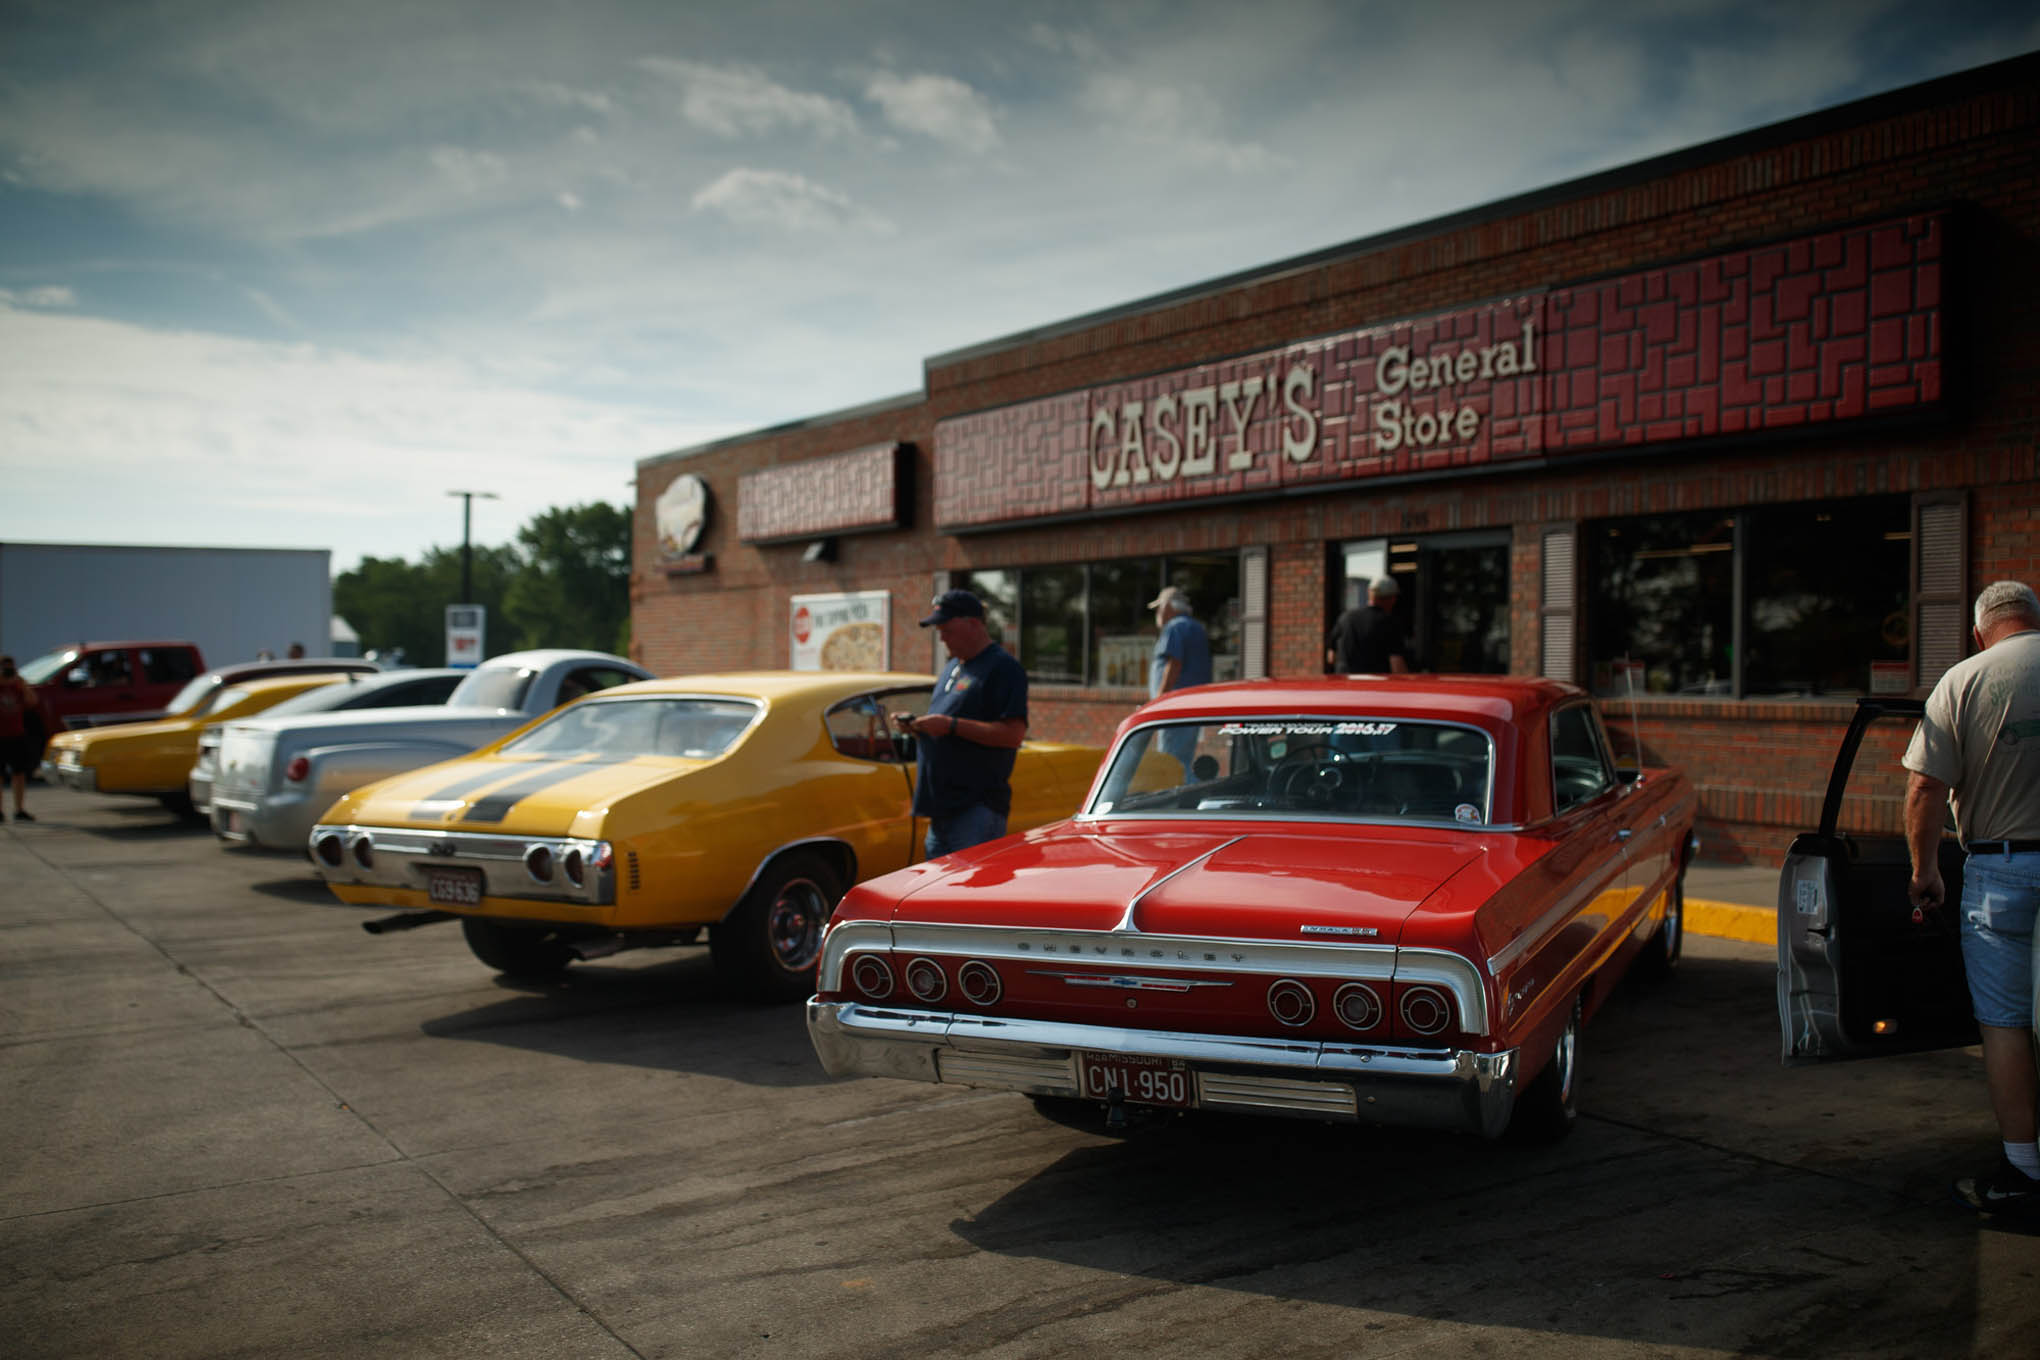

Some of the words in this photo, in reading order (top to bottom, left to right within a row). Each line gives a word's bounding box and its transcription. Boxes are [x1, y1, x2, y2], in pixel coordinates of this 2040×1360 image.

[1375, 323, 1536, 396] General
[1090, 363, 1318, 489] CASEY'S
[1375, 401, 1480, 451] Store
[1217, 727, 1282, 736] POWER
[1286, 727, 1333, 736] TOUR
